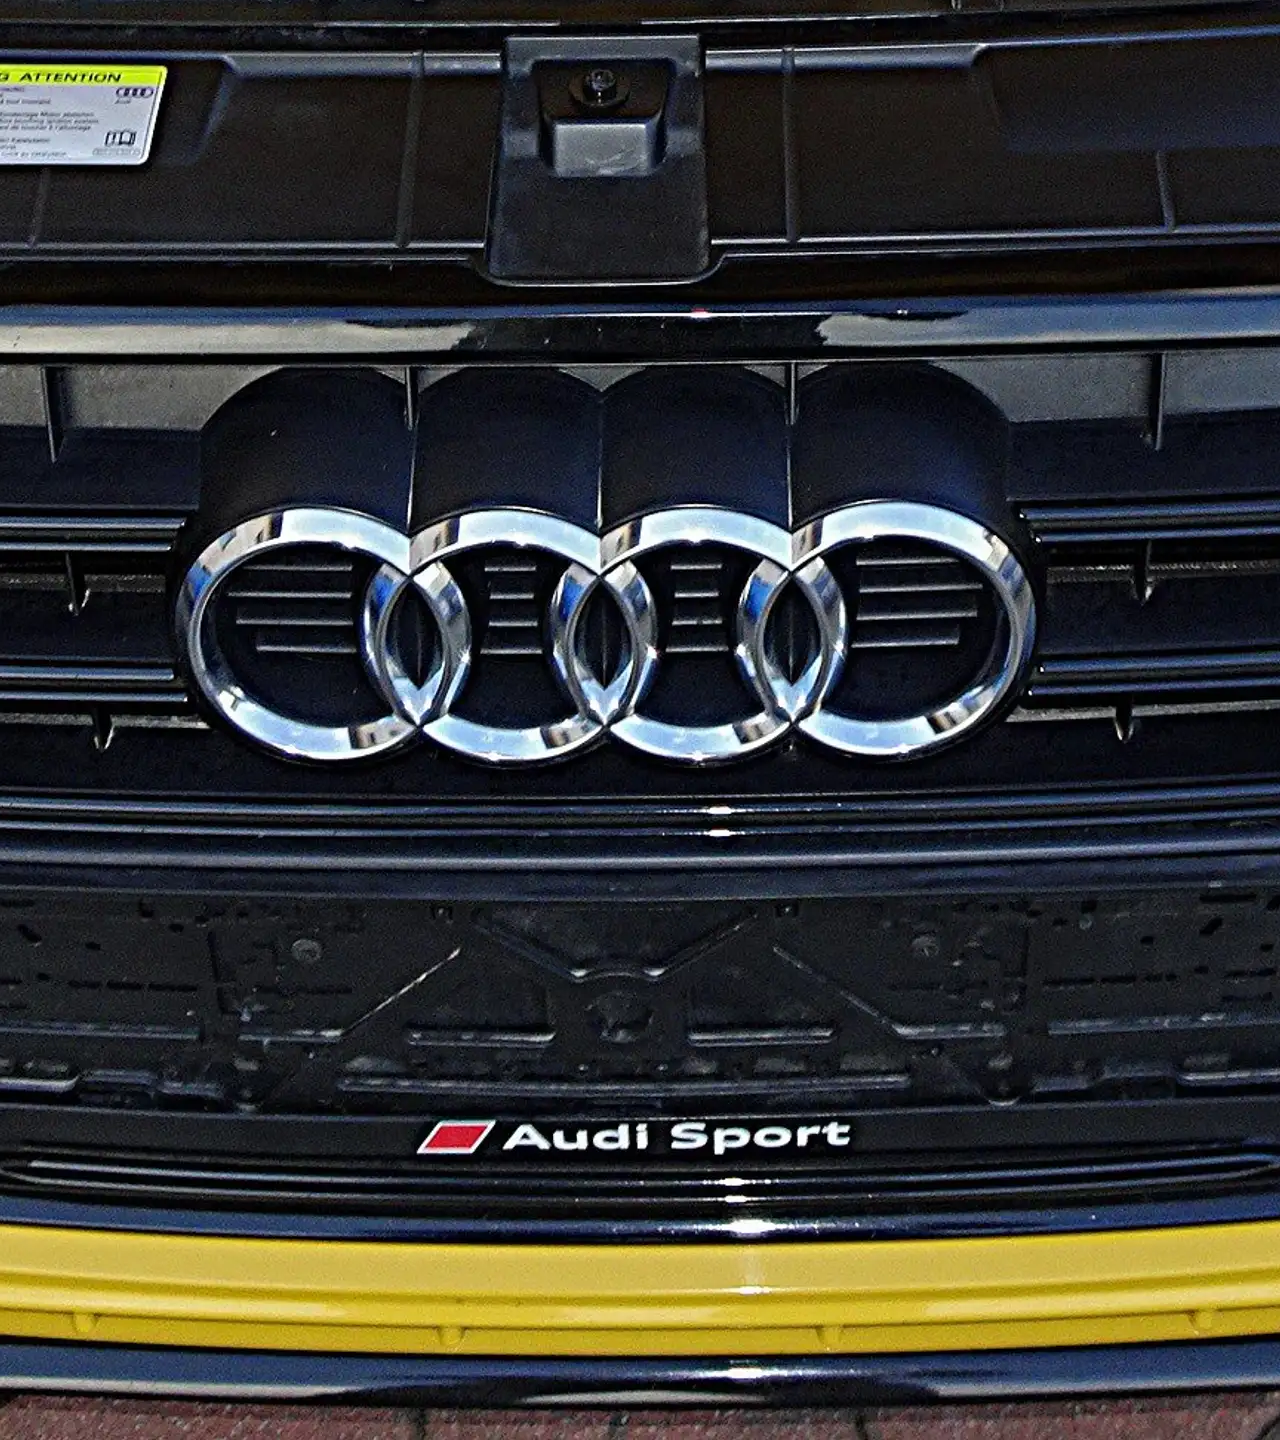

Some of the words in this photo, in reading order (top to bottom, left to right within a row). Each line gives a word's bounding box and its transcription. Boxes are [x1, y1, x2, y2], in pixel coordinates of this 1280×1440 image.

[19, 71, 122, 84] ATTENTION
[502, 1122, 649, 1152] Audi
[669, 1120, 852, 1156] Sport
